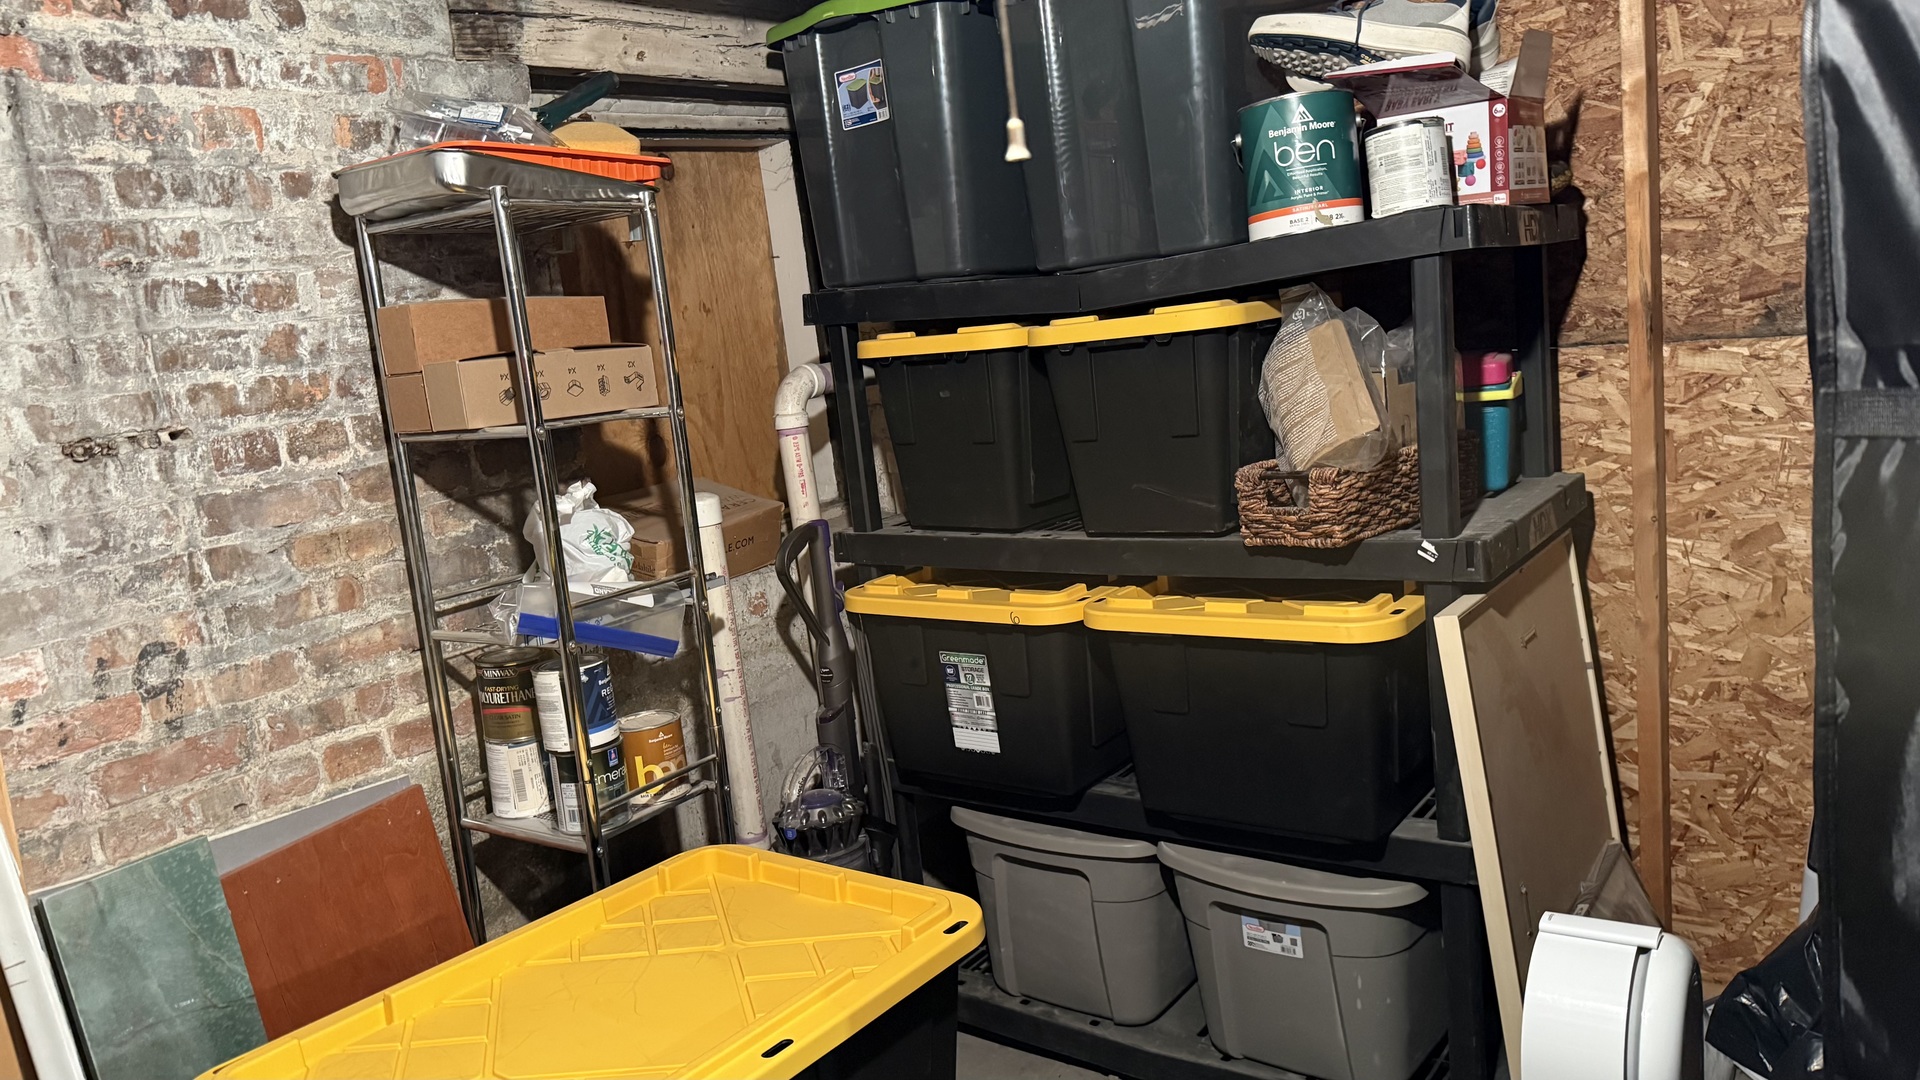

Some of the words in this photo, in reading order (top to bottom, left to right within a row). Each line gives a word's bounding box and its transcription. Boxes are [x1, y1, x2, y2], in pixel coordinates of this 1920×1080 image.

[1268, 123, 1308, 139] Benjamin
[1309, 121, 1335, 130] Moore
[1274, 139, 1336, 167] ben
[1294, 185, 1324, 195] INTERIOR
[567, 367, 577, 375] X4
[500, 373, 510, 381] X4
[725, 536, 755, 556] E.COM
[1009, 611, 1021, 625] 6
[941, 653, 985, 665] Greenmade
[483, 668, 515, 678] MINWAX
[961, 666, 985, 674] STORAGE
[484, 684, 519, 692] FAST-DRYING
[594, 765, 626, 786] Emera
